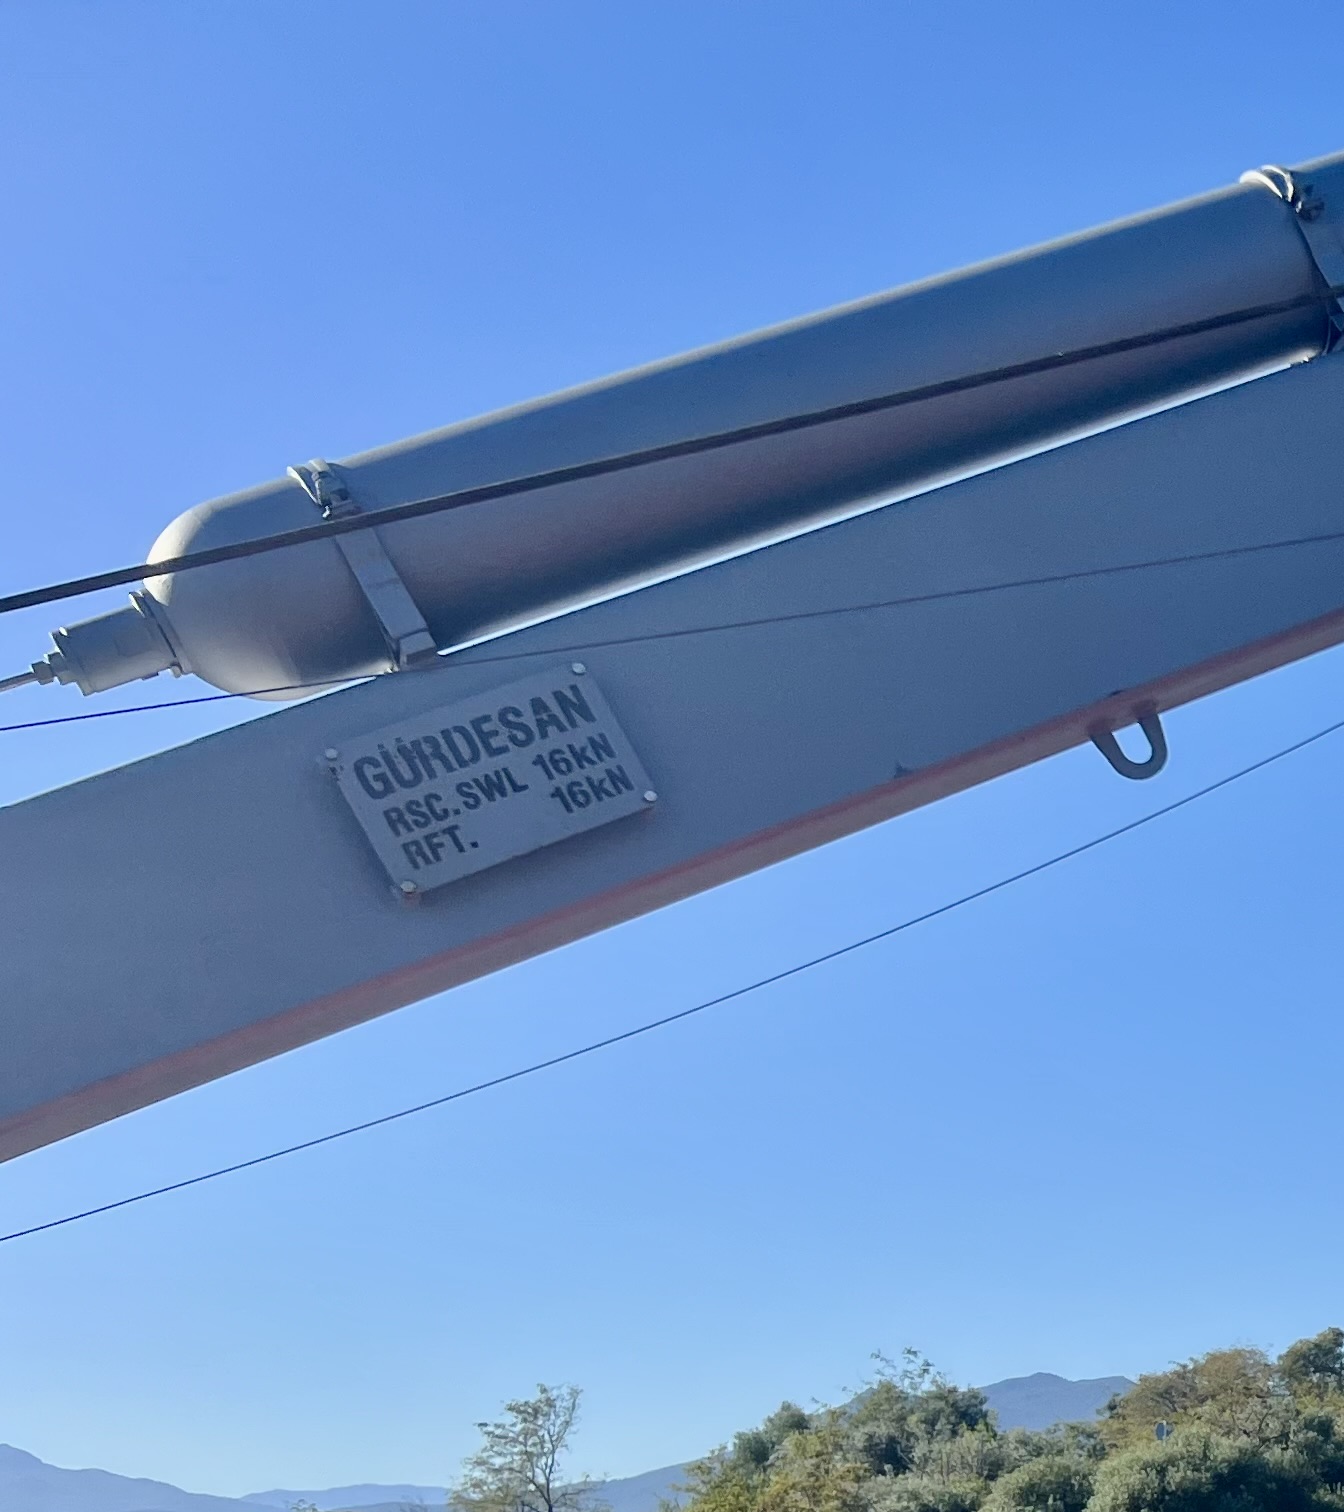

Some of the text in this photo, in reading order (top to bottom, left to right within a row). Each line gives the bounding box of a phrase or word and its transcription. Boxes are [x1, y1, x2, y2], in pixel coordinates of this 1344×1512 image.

[531, 732, 617, 782] 16kN
[401, 764, 636, 871] RFT. 16kN
